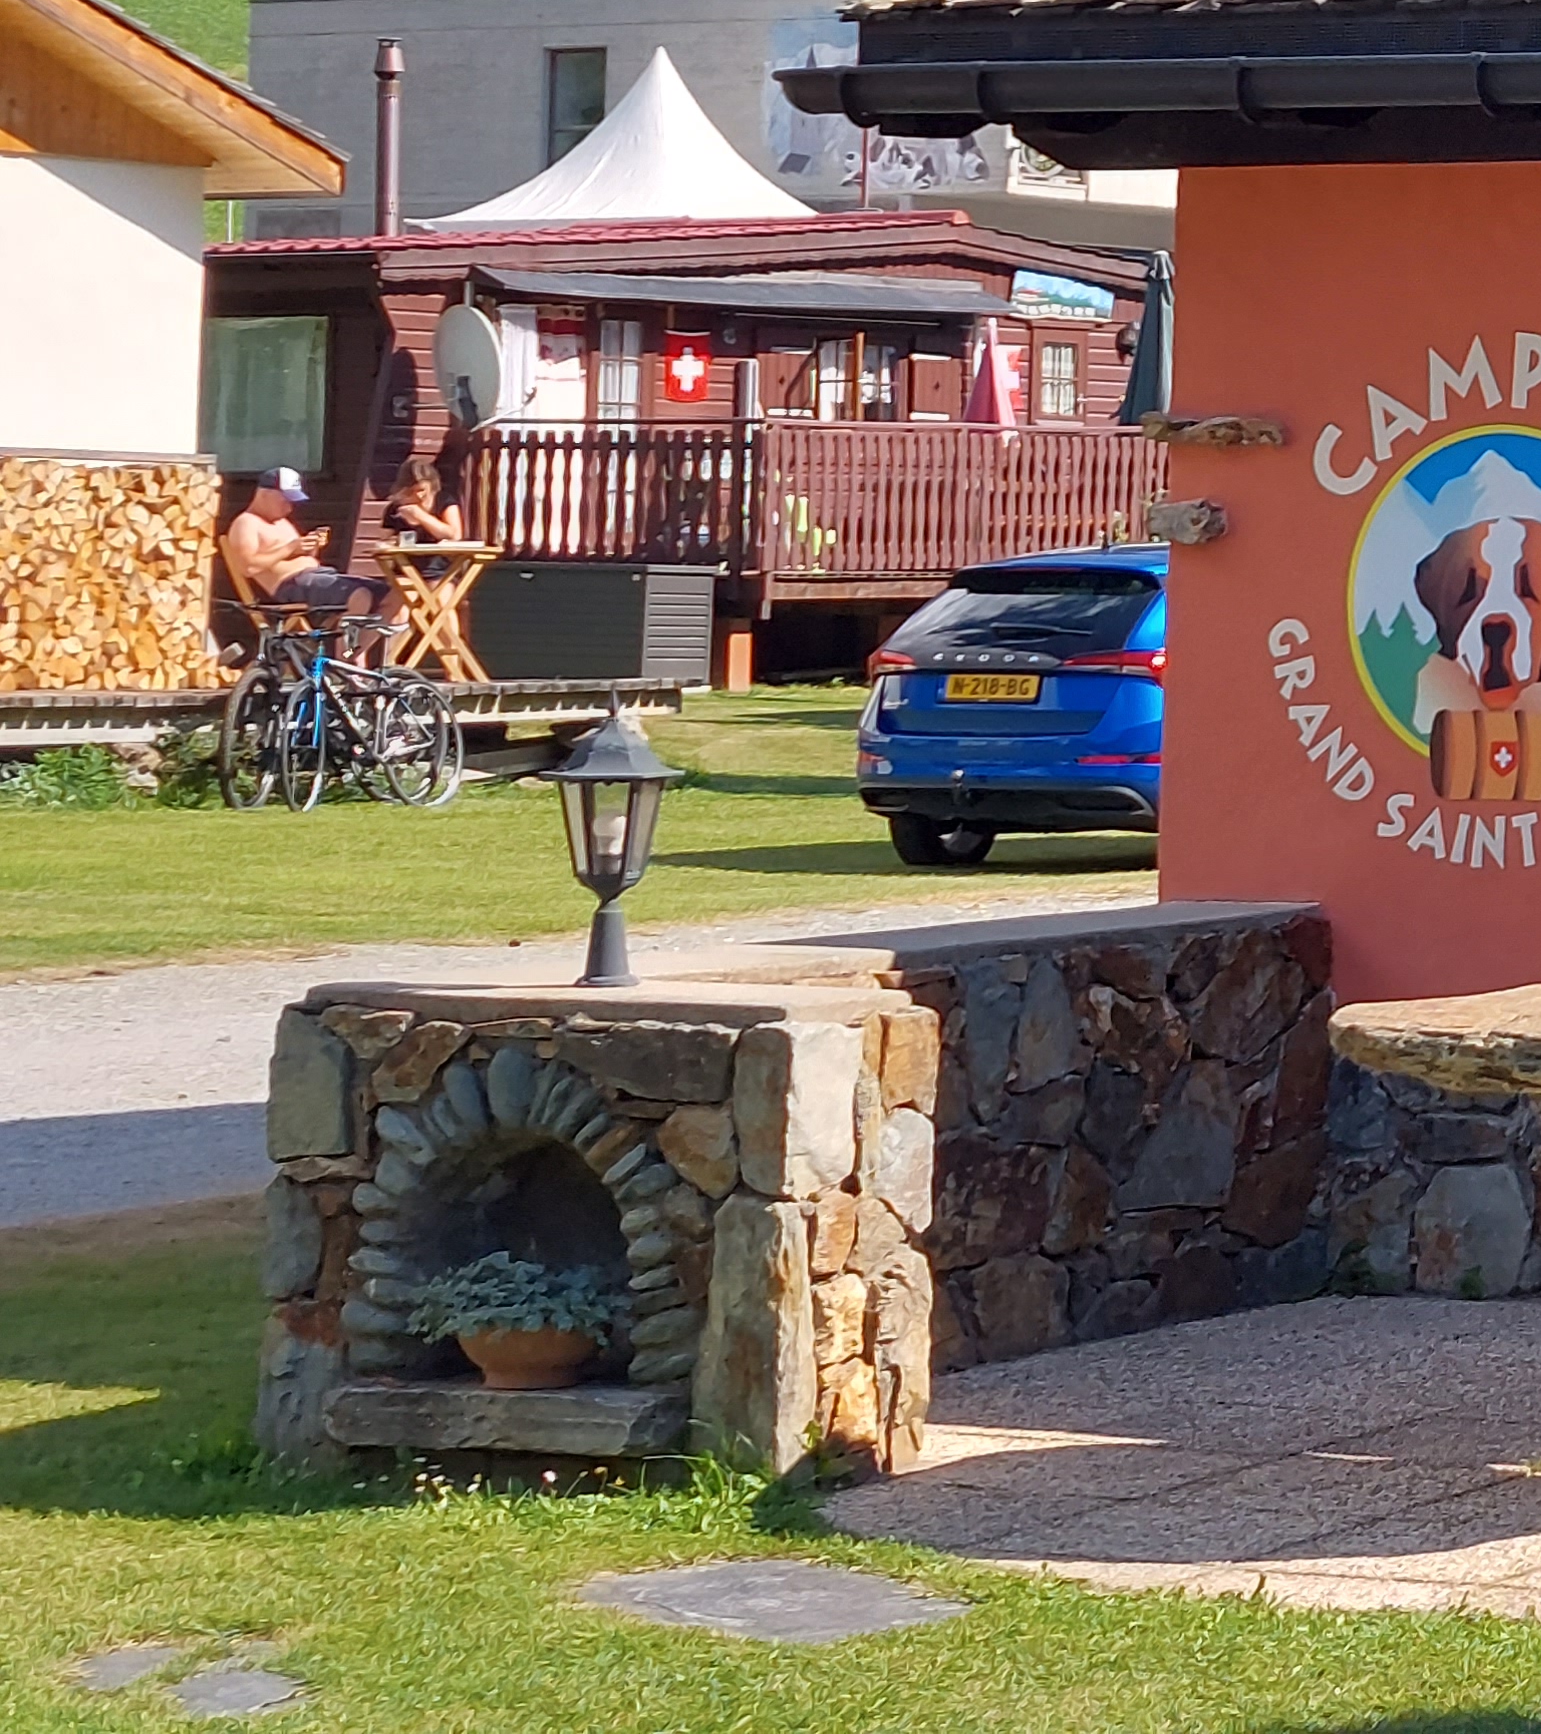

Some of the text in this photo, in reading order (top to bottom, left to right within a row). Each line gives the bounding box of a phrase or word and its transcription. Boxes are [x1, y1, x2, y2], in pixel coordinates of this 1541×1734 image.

[951, 677, 1032, 696] N-218-BG
[1268, 618, 1375, 801] GRAND
[1378, 794, 1538, 869] SAINT
